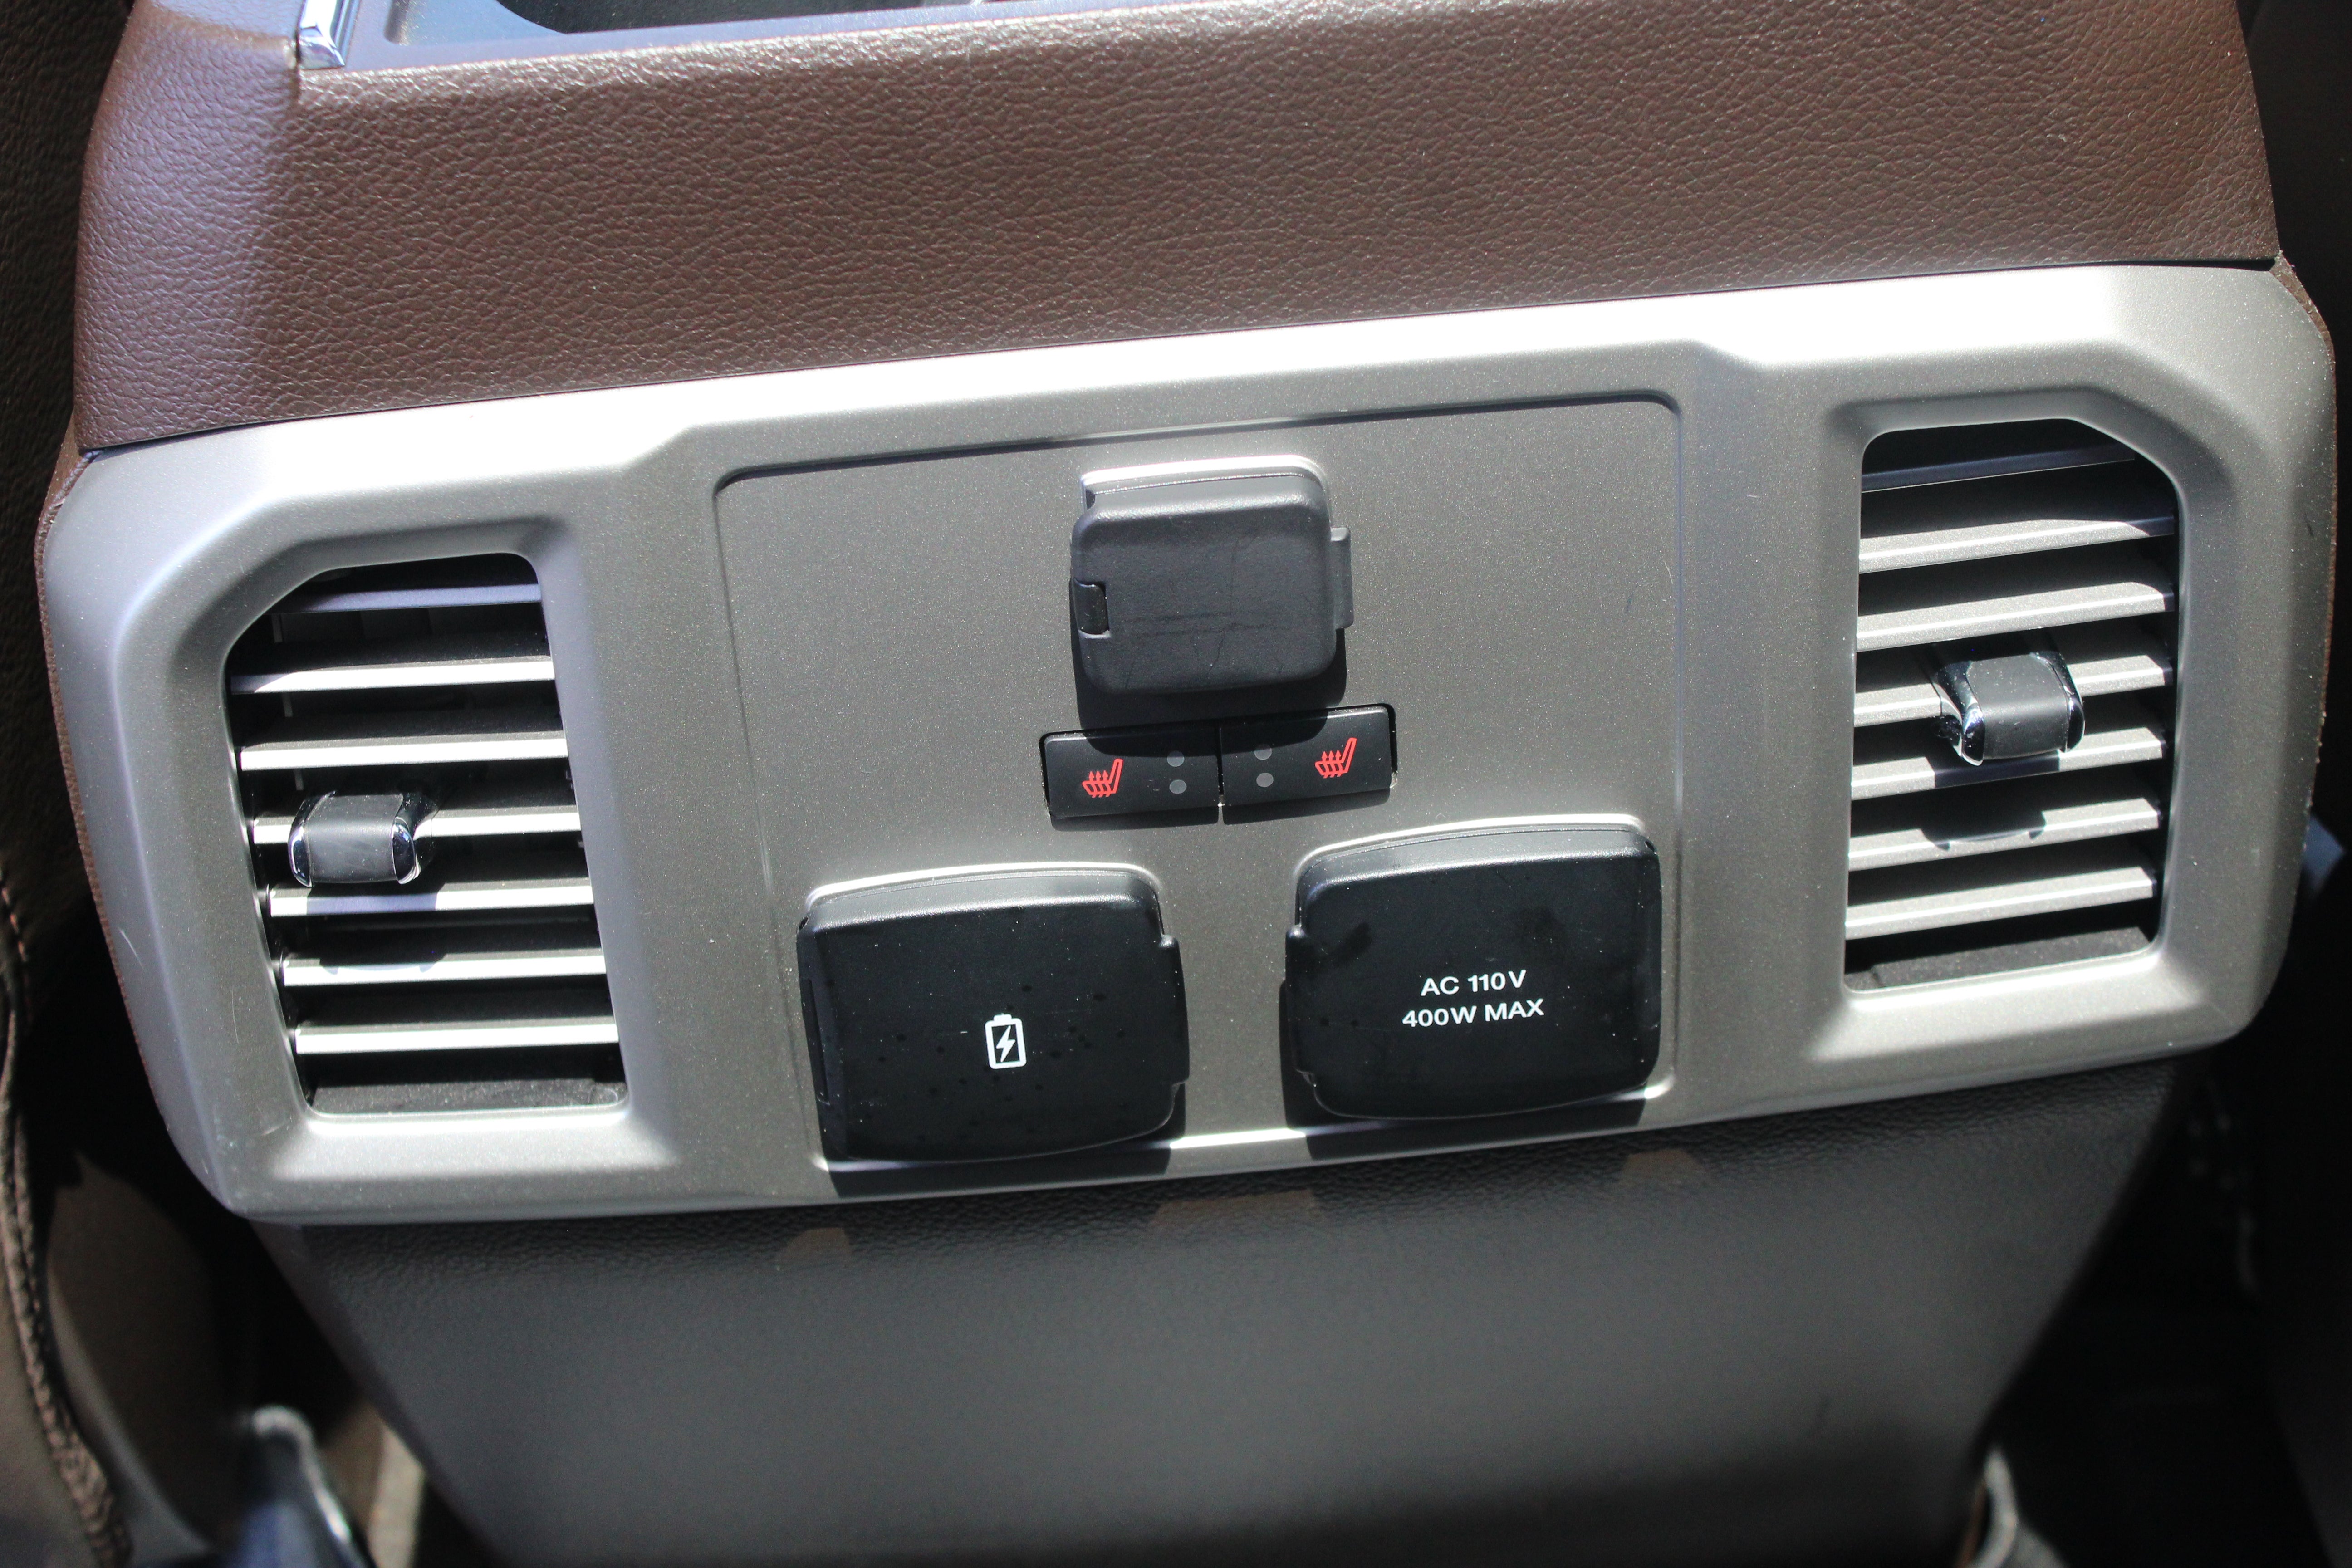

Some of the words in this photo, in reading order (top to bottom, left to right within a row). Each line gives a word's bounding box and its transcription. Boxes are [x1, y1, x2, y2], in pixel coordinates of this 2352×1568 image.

[1421, 976, 1460, 996] AC
[1467, 969, 1527, 992] 110V
[1402, 1005, 1477, 1027] 400W
[1485, 998, 1544, 1022] MAX
